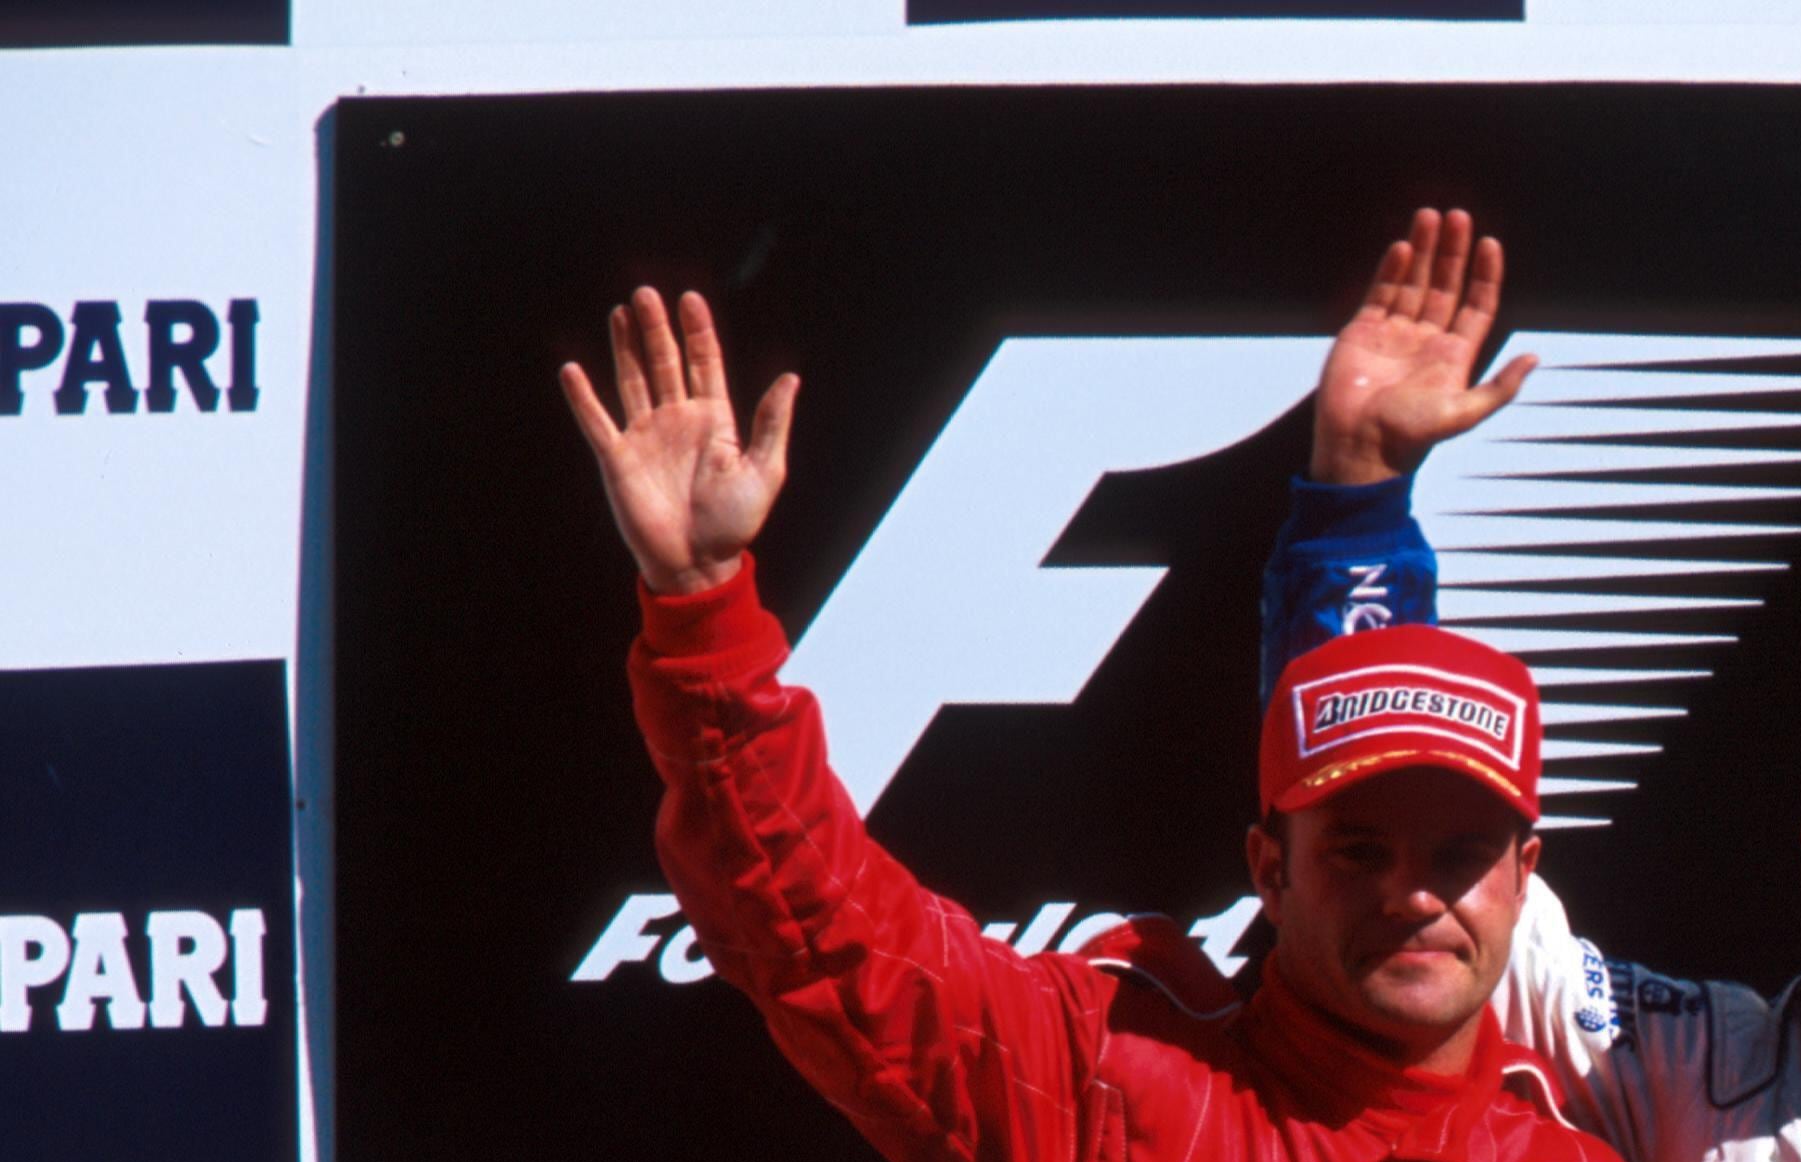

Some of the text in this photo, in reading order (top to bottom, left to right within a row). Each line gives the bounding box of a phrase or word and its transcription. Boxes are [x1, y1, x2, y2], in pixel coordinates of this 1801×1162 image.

[0, 298, 260, 415] PARI
[1312, 687, 1511, 740] BRIDGESTONE
[0, 908, 267, 1033] PARI
